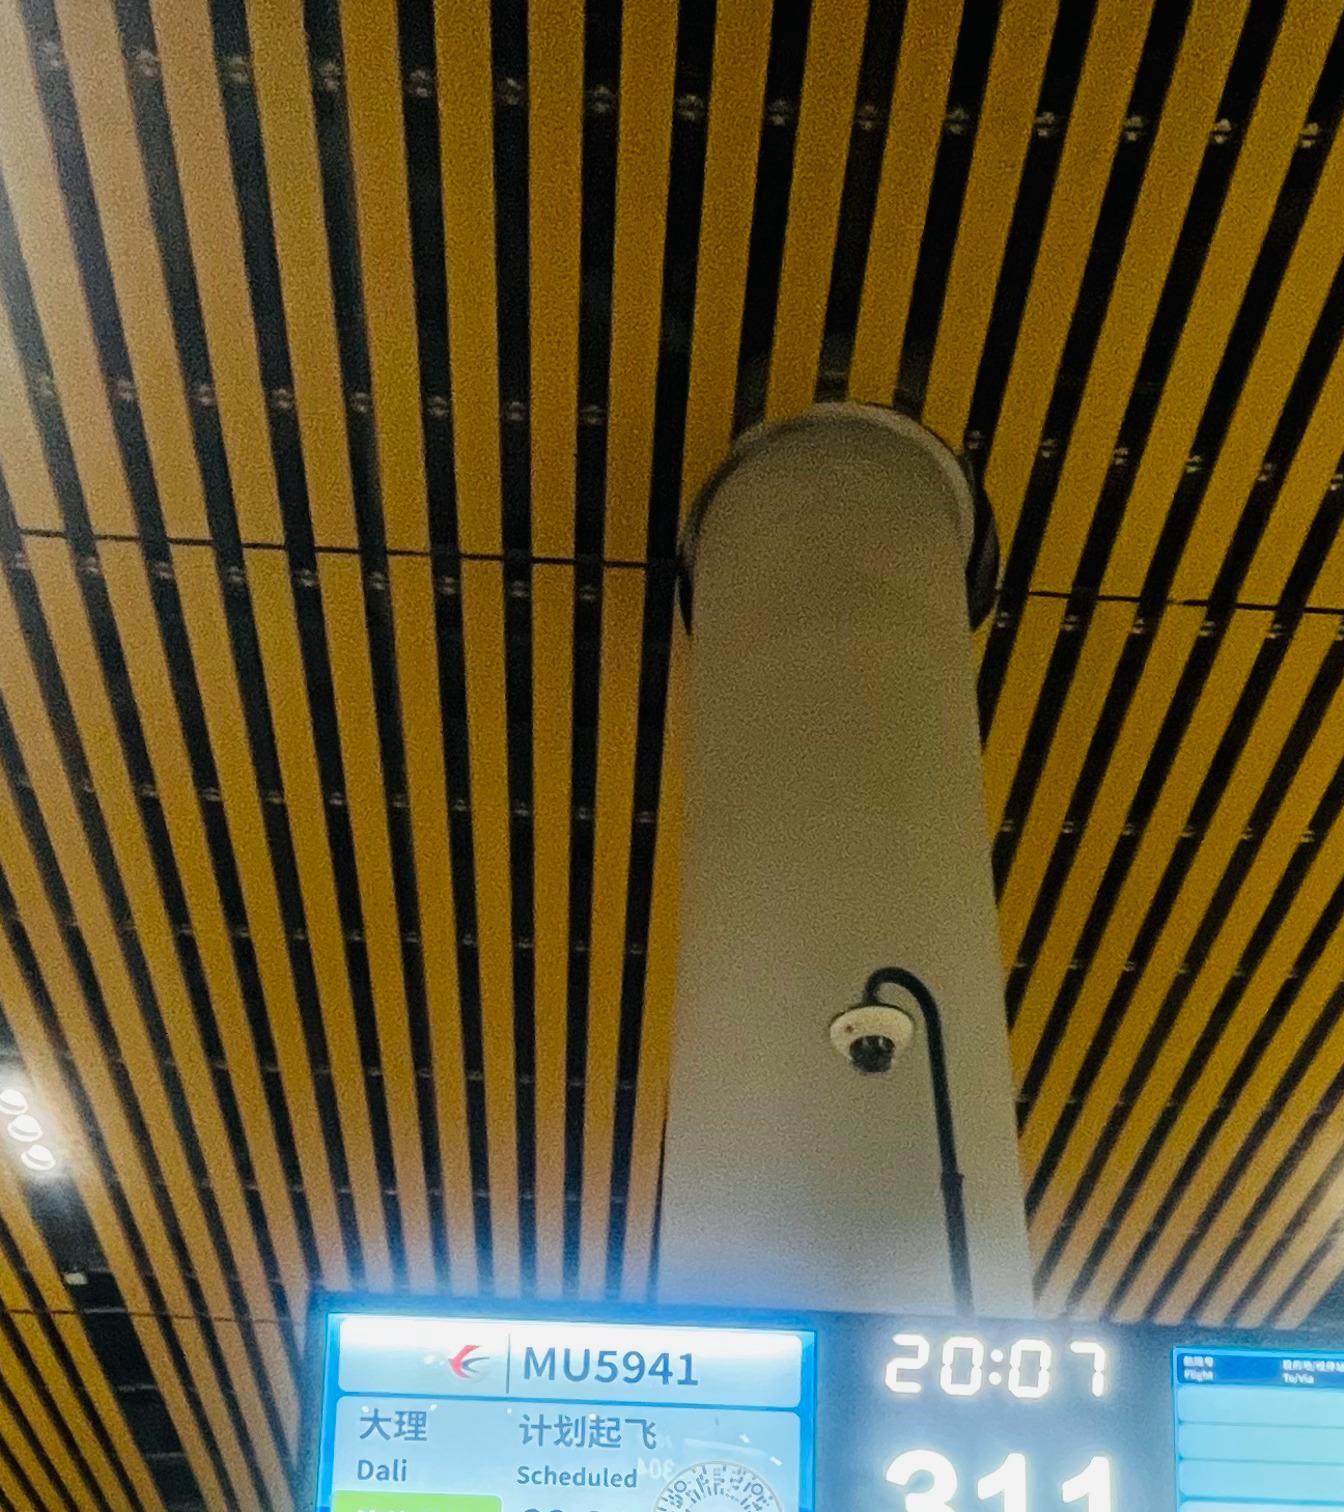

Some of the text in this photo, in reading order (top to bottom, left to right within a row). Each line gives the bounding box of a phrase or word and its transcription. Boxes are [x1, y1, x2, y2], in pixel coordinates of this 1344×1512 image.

[522, 1345, 700, 1387] MU5941
[884, 1333, 1107, 1399] 20:07
[358, 1407, 429, 1443] 大理
[518, 1413, 657, 1451] 计划起飞
[356, 1457, 408, 1482] Dali
[516, 1464, 638, 1490] Scheduled
